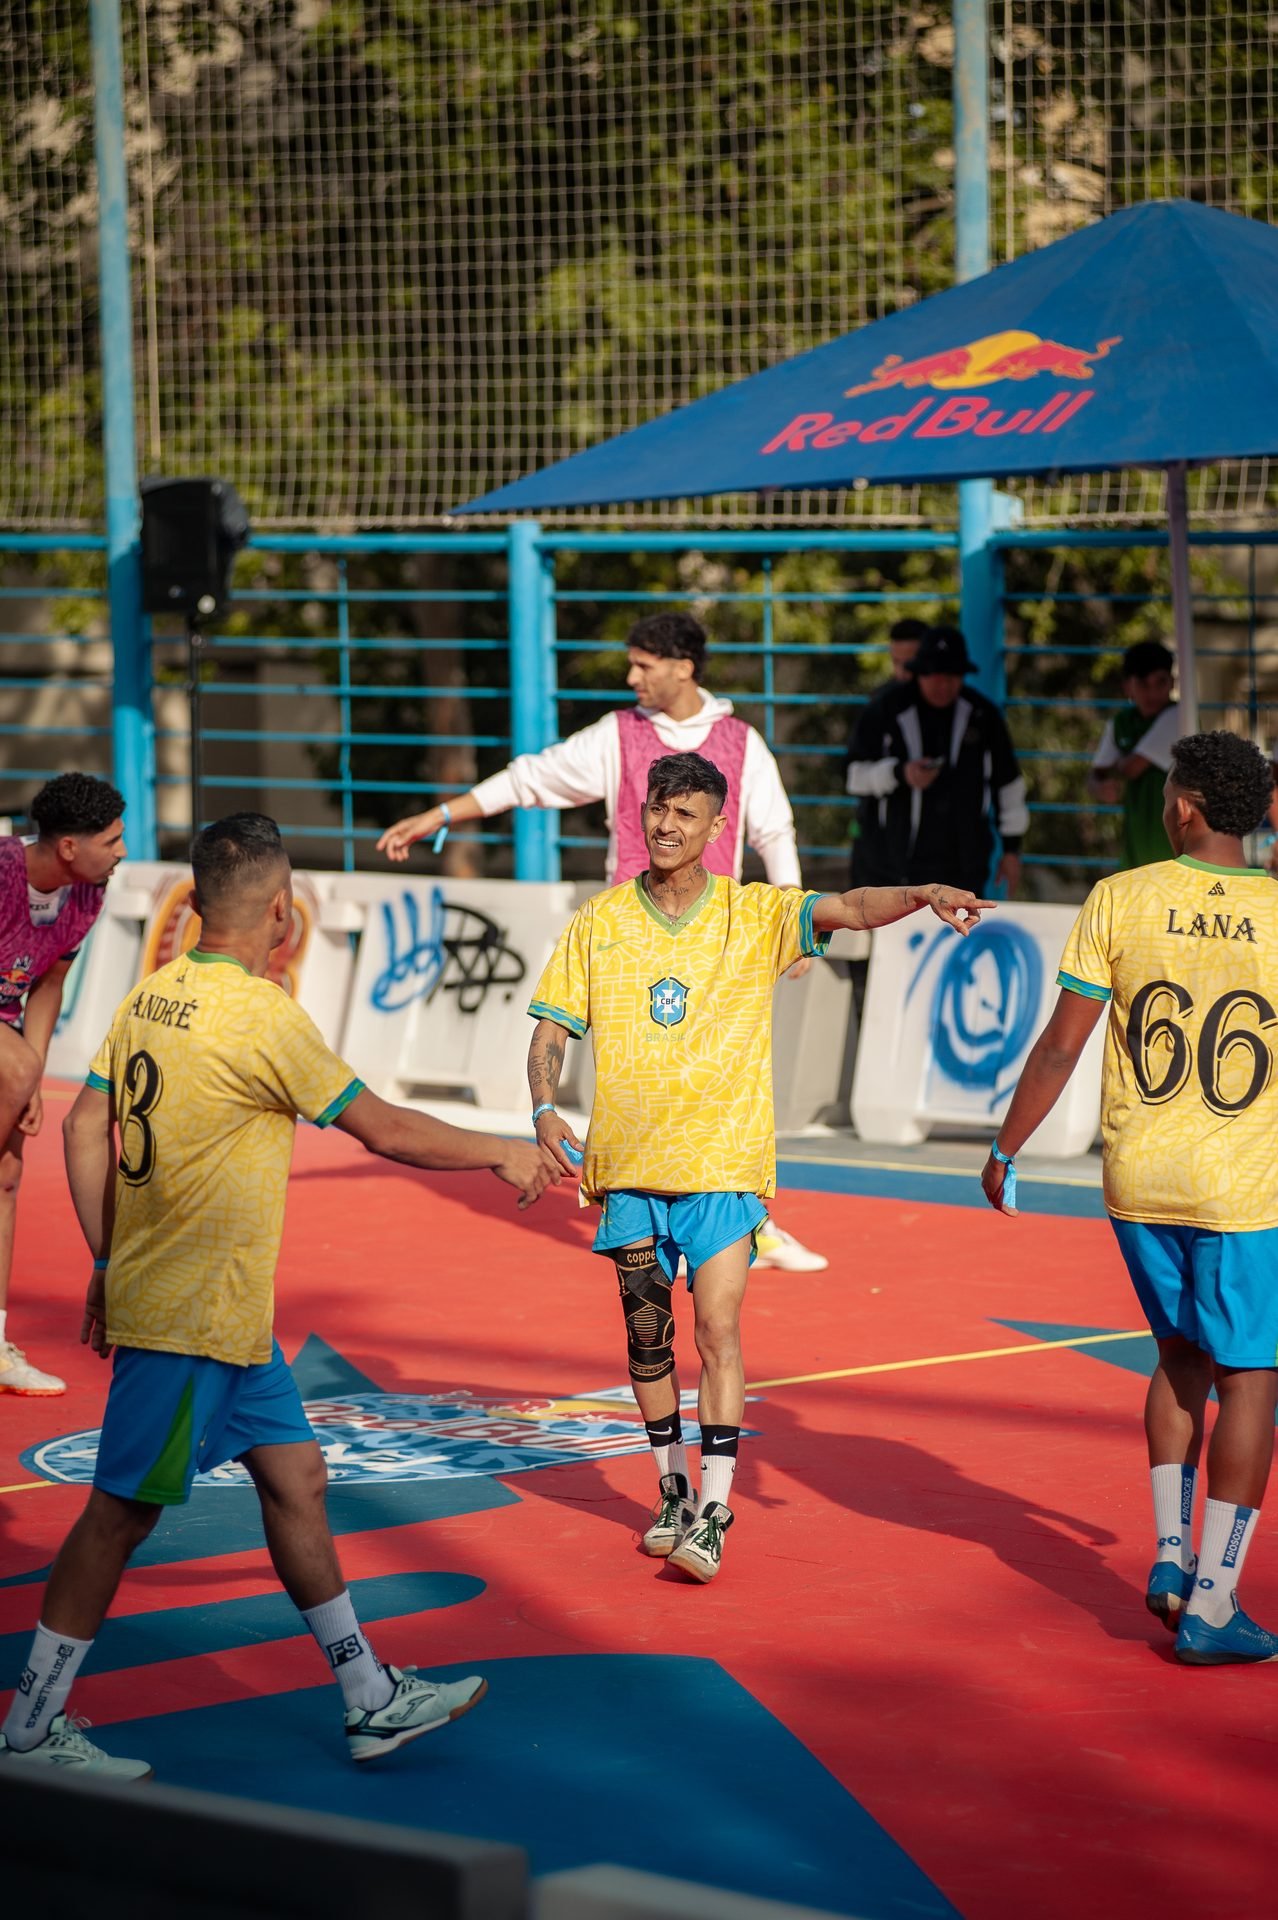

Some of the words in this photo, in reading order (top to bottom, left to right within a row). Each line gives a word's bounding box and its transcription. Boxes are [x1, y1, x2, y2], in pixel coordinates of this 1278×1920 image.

[760, 397, 935, 455] Red
[913, 389, 1096, 438] Bull
[1166, 908, 1258, 944] LANA
[128, 991, 199, 1031] ANDRÉ
[646, 1032, 686, 1042] BRASIL
[1126, 980, 1278, 1118] 66
[626, 1249, 656, 1266] coppe
[1182, 1476, 1193, 1521] PROSOCKS
[1224, 1518, 1247, 1564] PROSOCKS
[329, 1635, 361, 1666] FS
